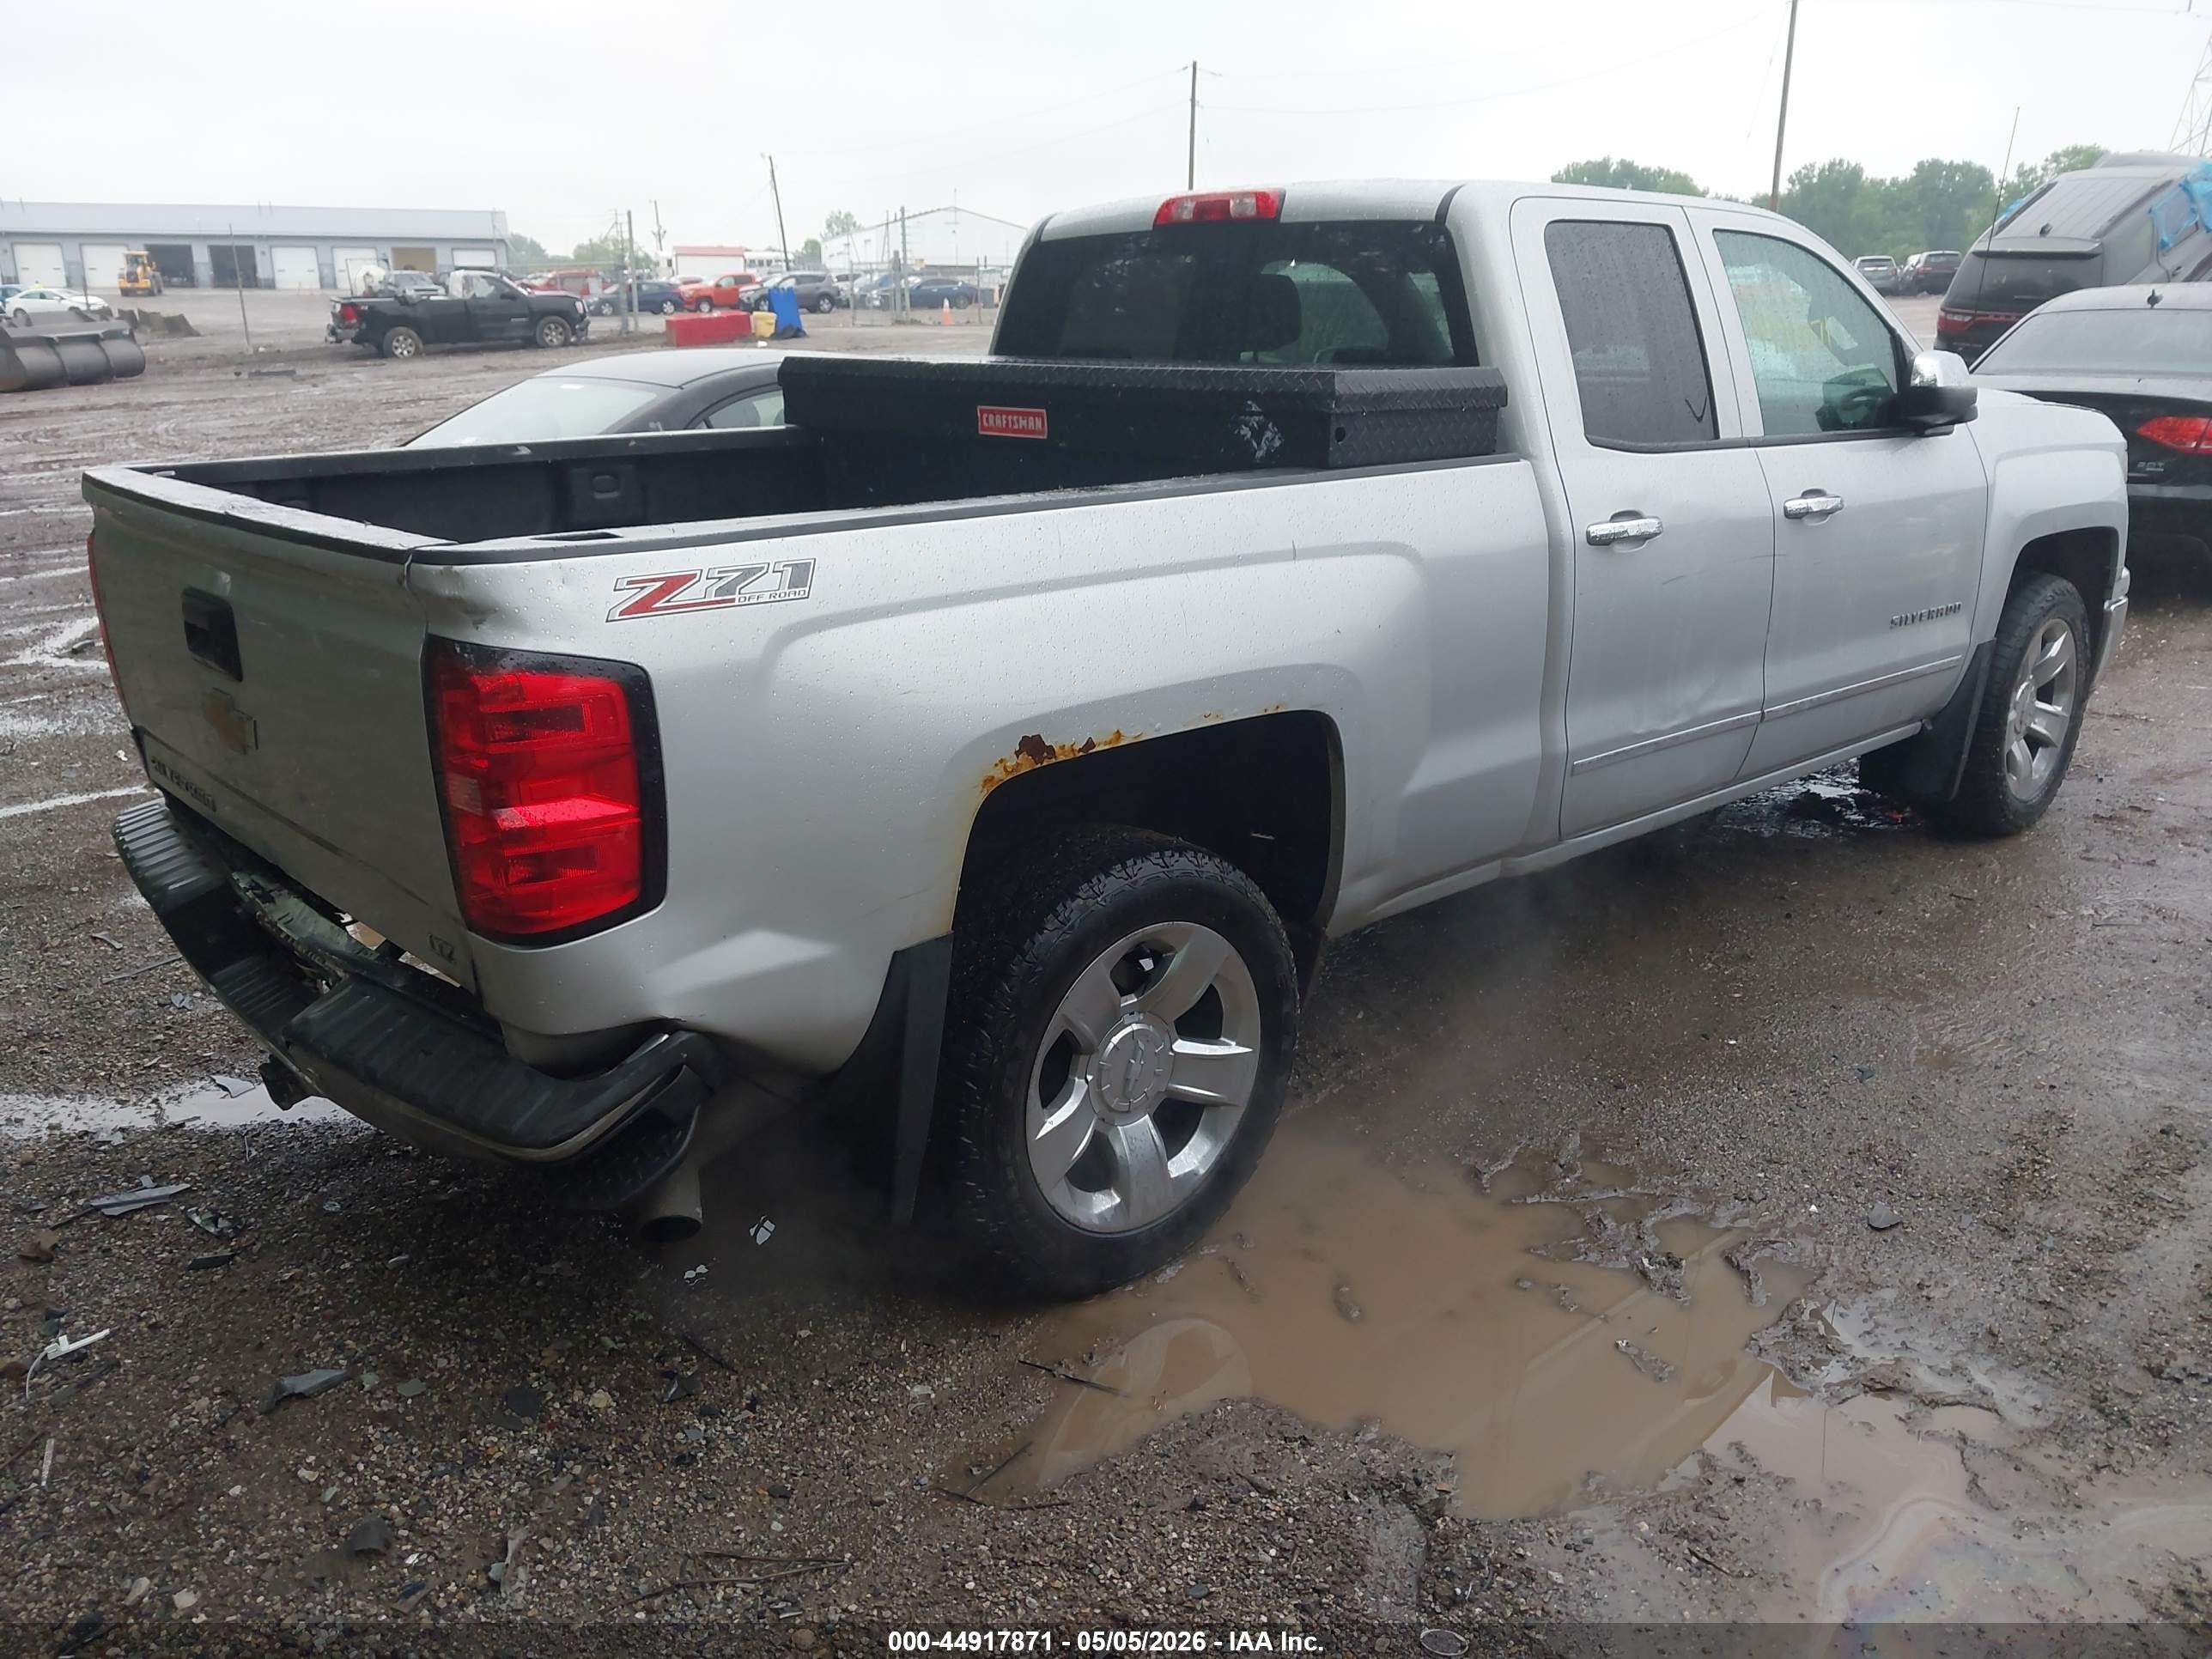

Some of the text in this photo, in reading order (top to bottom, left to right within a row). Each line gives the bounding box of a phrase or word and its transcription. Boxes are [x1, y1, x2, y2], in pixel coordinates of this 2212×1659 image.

[982, 413, 1042, 430] CRAFTSMAN
[605, 558, 817, 623] Z71
[738, 590, 806, 603] OFF ROAD
[1889, 601, 1962, 629] SILVERADO
